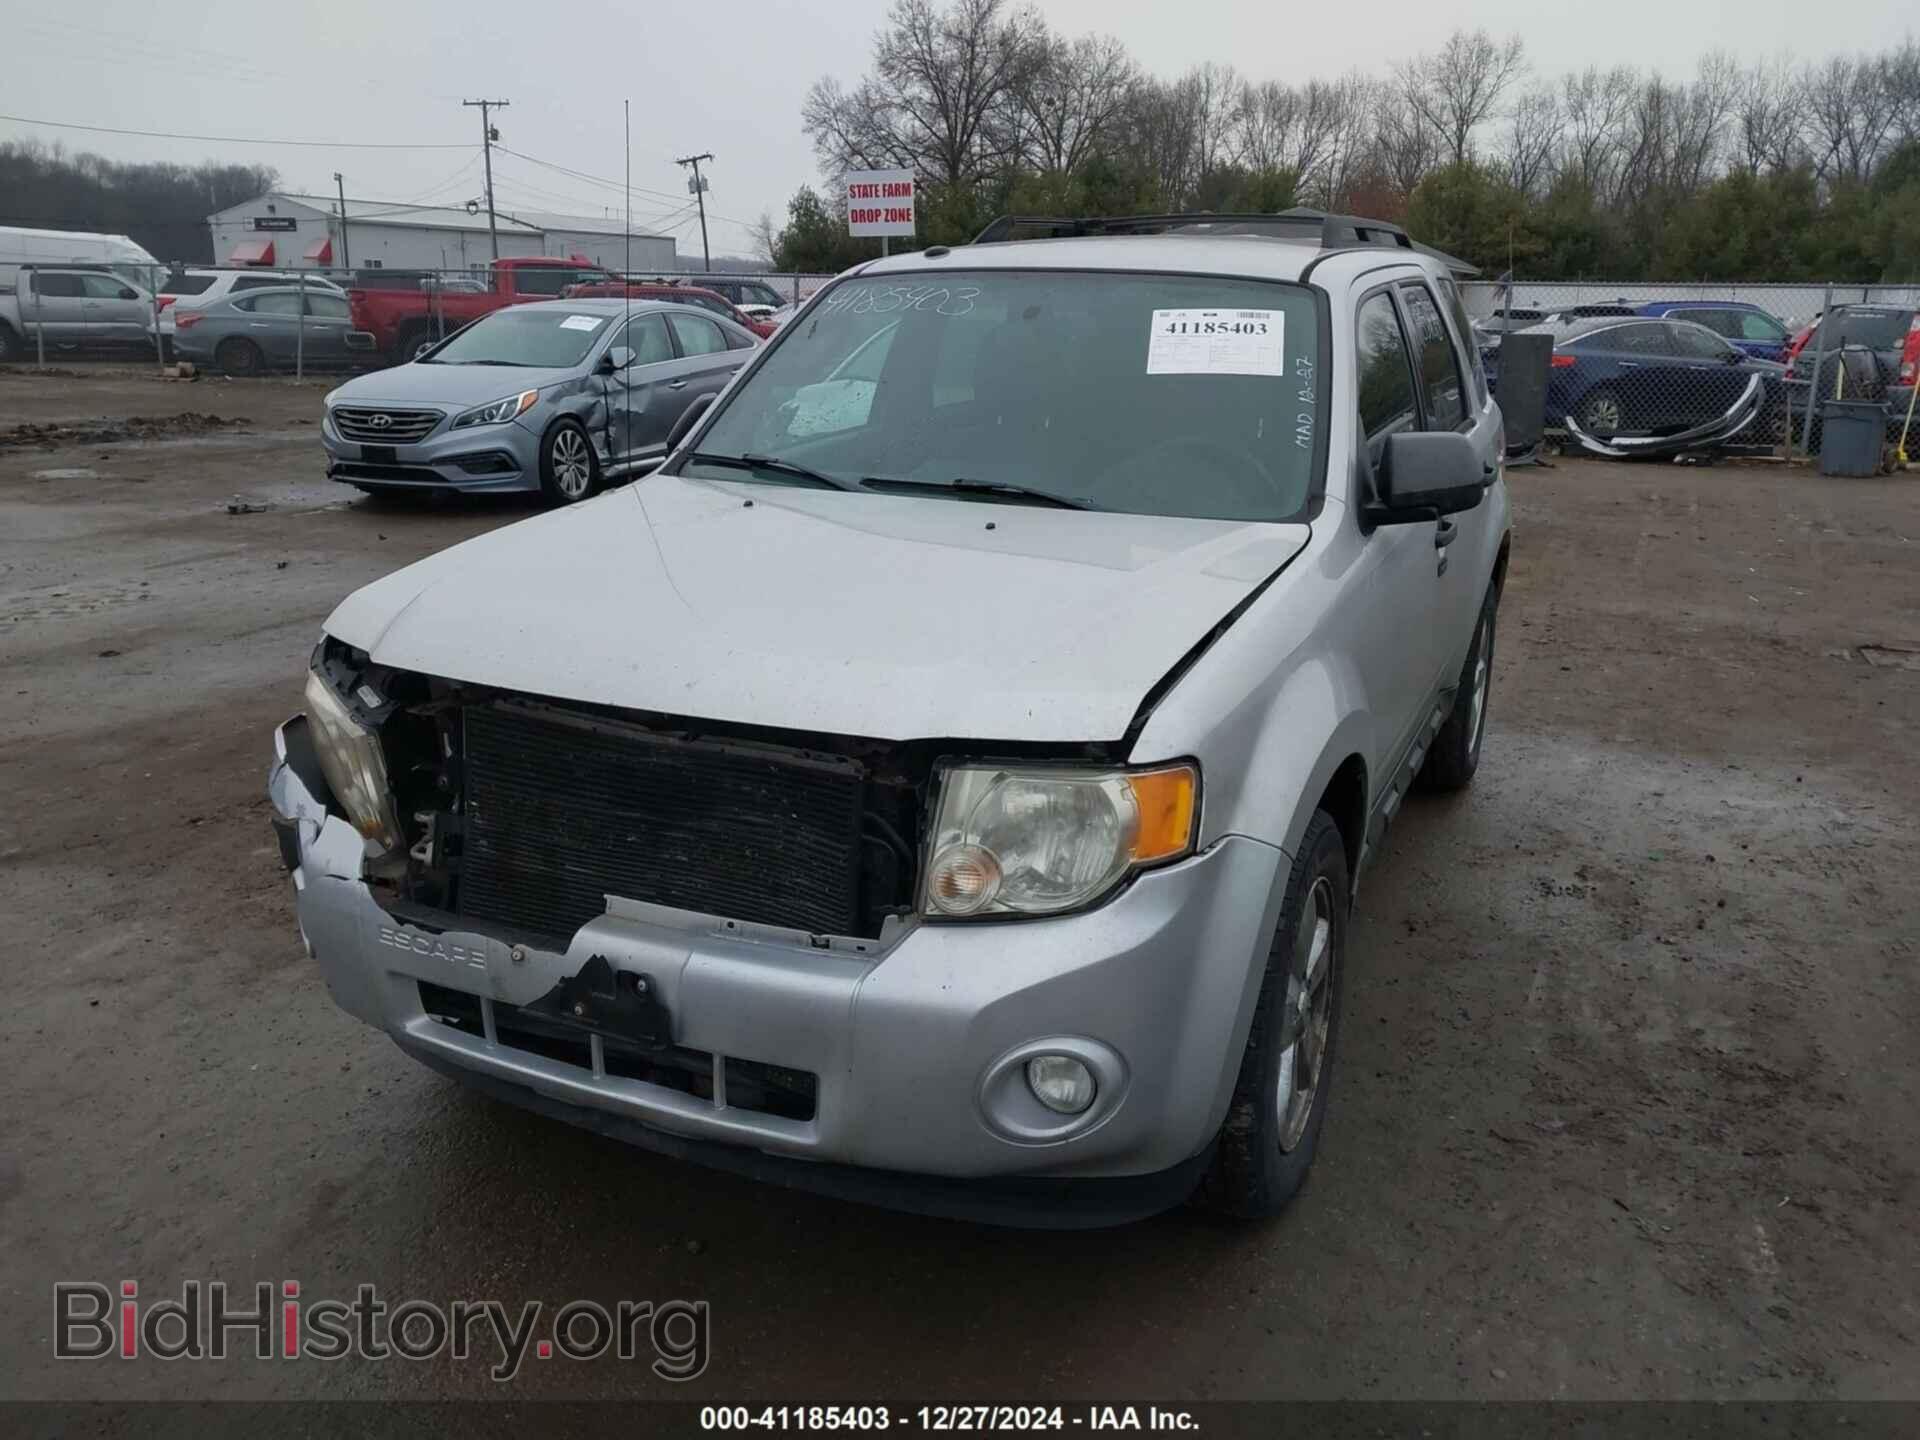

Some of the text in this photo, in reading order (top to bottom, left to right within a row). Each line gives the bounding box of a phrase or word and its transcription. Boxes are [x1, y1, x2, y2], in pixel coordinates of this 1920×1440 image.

[849, 183, 911, 199] STATE FARM
[851, 208, 912, 223] DROP ZONE
[1166, 322, 1268, 335] 41185403
[1294, 413, 1314, 448] MAD
[379, 927, 486, 969] ESCAPE
